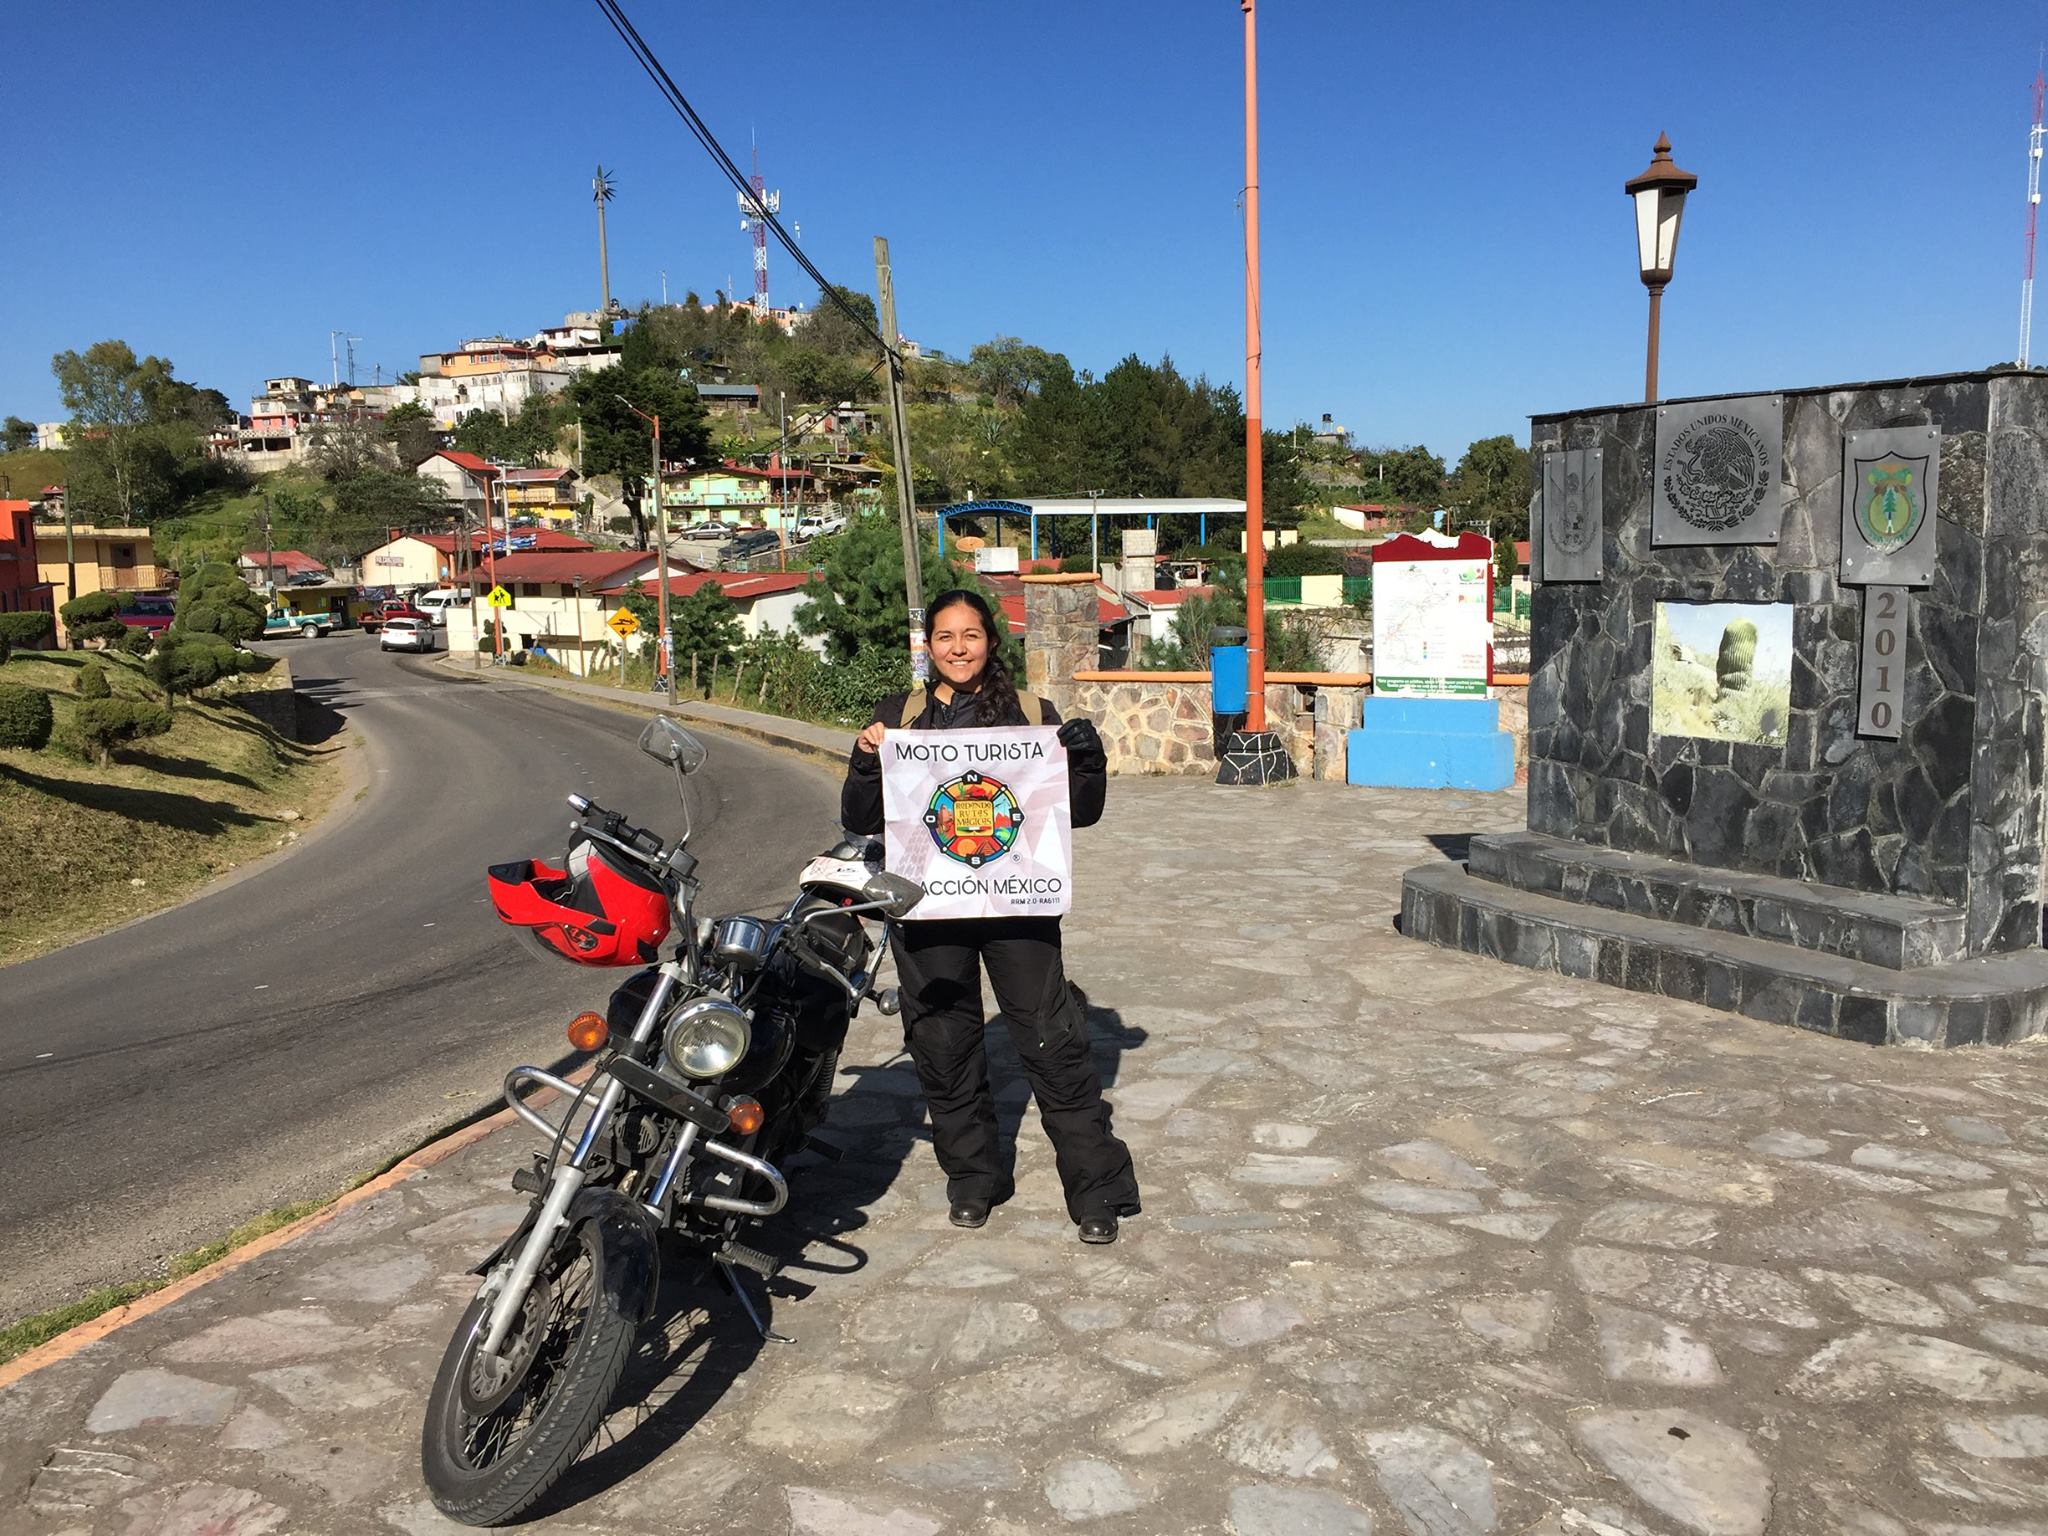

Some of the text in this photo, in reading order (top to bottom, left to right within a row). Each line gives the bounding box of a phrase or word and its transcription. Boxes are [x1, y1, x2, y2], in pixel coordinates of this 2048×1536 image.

[1663, 413, 1770, 471] ESTADOS UNIDOS MEXICANOS
[1871, 592, 1897, 729] 2010
[895, 741, 1044, 762] MOTO TURISTA
[966, 774, 978, 782] N
[925, 815, 936, 823] O
[971, 856, 981, 865] S
[920, 874, 1062, 896] ACCIÓN MÉXICO
